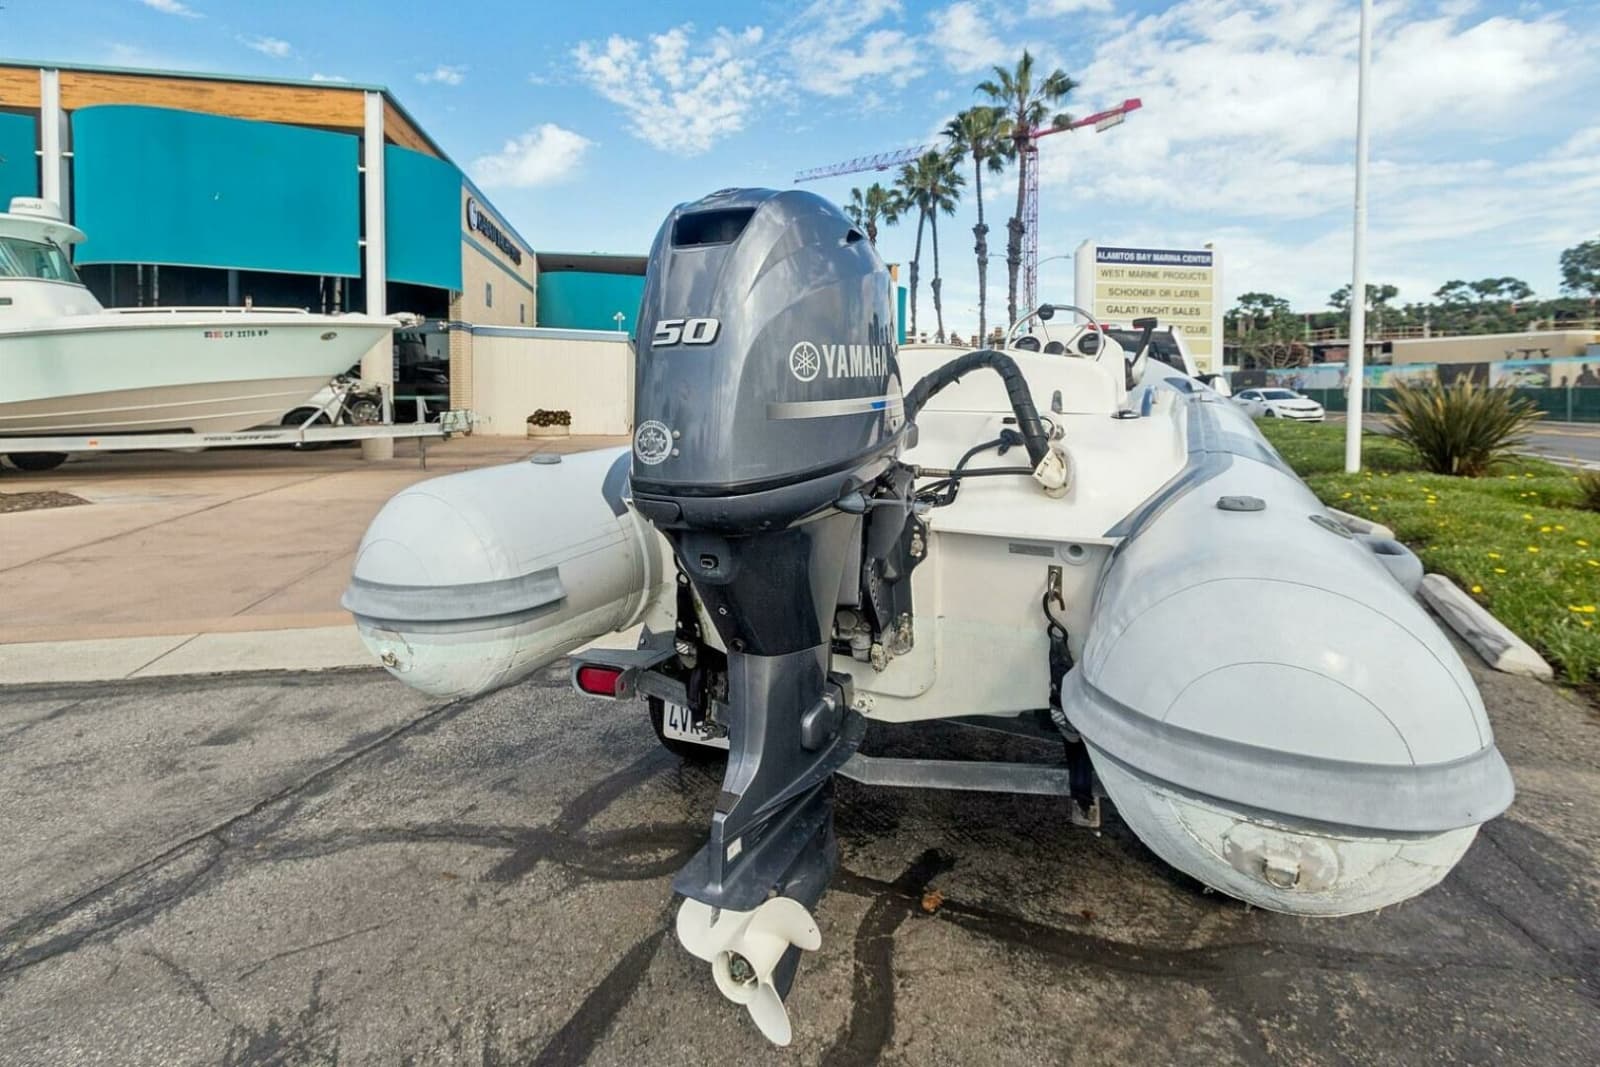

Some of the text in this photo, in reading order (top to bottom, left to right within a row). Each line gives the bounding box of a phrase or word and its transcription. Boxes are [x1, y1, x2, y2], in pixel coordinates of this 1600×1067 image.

[1097, 251, 1211, 264] ALAMITOS BAY MARINA CENTER
[1101, 269, 1208, 280] WEST MARINE PRODUCTS
[1108, 288, 1200, 298] SCHOONER OR LATER
[1106, 305, 1201, 316] GALATI YACHT SALES
[652, 318, 721, 348] 50
[1185, 325, 1208, 334] CLUB
[822, 344, 888, 379] YAMAHA
